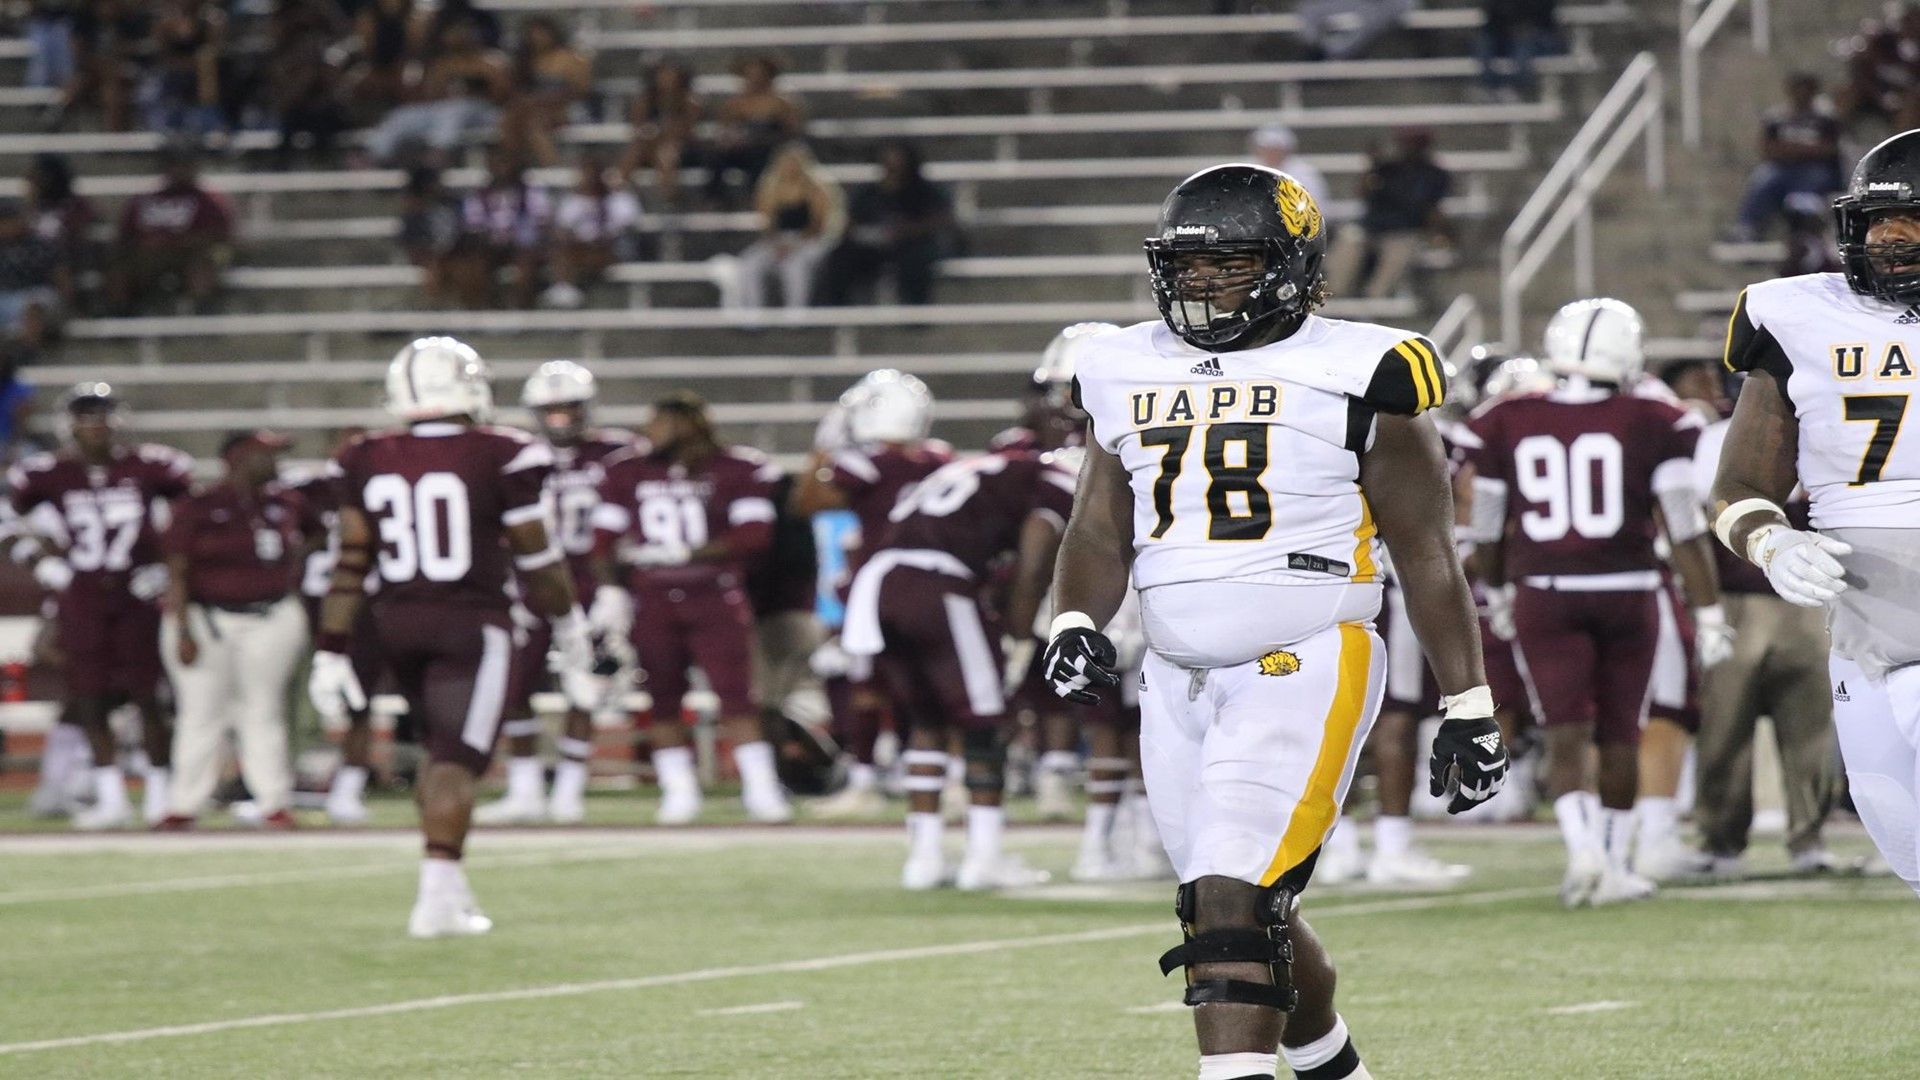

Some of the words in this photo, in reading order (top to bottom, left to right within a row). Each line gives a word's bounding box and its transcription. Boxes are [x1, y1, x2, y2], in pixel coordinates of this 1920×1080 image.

[1176, 225, 1206, 235] Riddell
[1893, 316, 1920, 325] adid
[1190, 366, 1224, 377] adidas
[1131, 383, 1280, 427] UAPB
[1842, 393, 1911, 487] 7
[1139, 420, 1273, 541] 78
[1513, 431, 1625, 542] 90
[64, 501, 146, 572] 37
[362, 471, 473, 582] 30
[638, 497, 709, 551] 91
[1472, 731, 1501, 744] adidas
